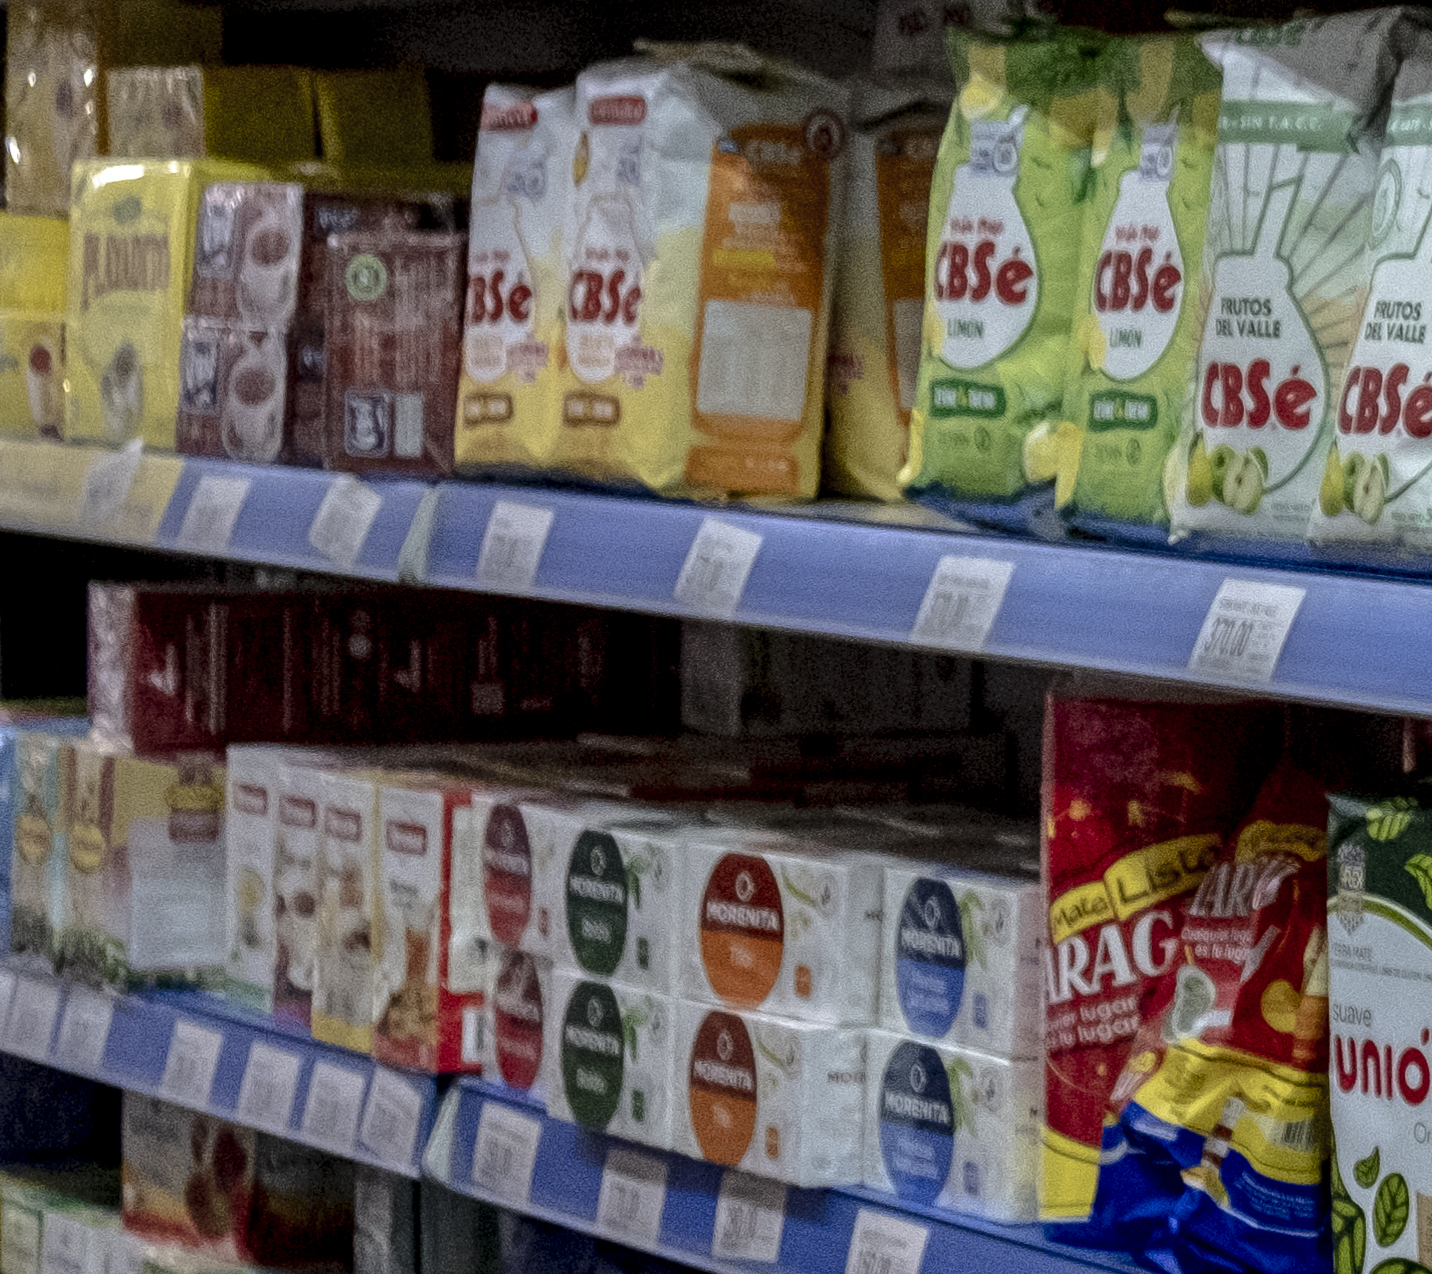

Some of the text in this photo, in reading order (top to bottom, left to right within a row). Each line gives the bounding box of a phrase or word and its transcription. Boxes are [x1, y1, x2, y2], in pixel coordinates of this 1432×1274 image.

[1094, 254, 1182, 314] CBSé
[1221, 298, 1272, 319] FRUTOS
[1216, 318, 1280, 341] DEL VALLE
[1202, 358, 1318, 430] CBSé
